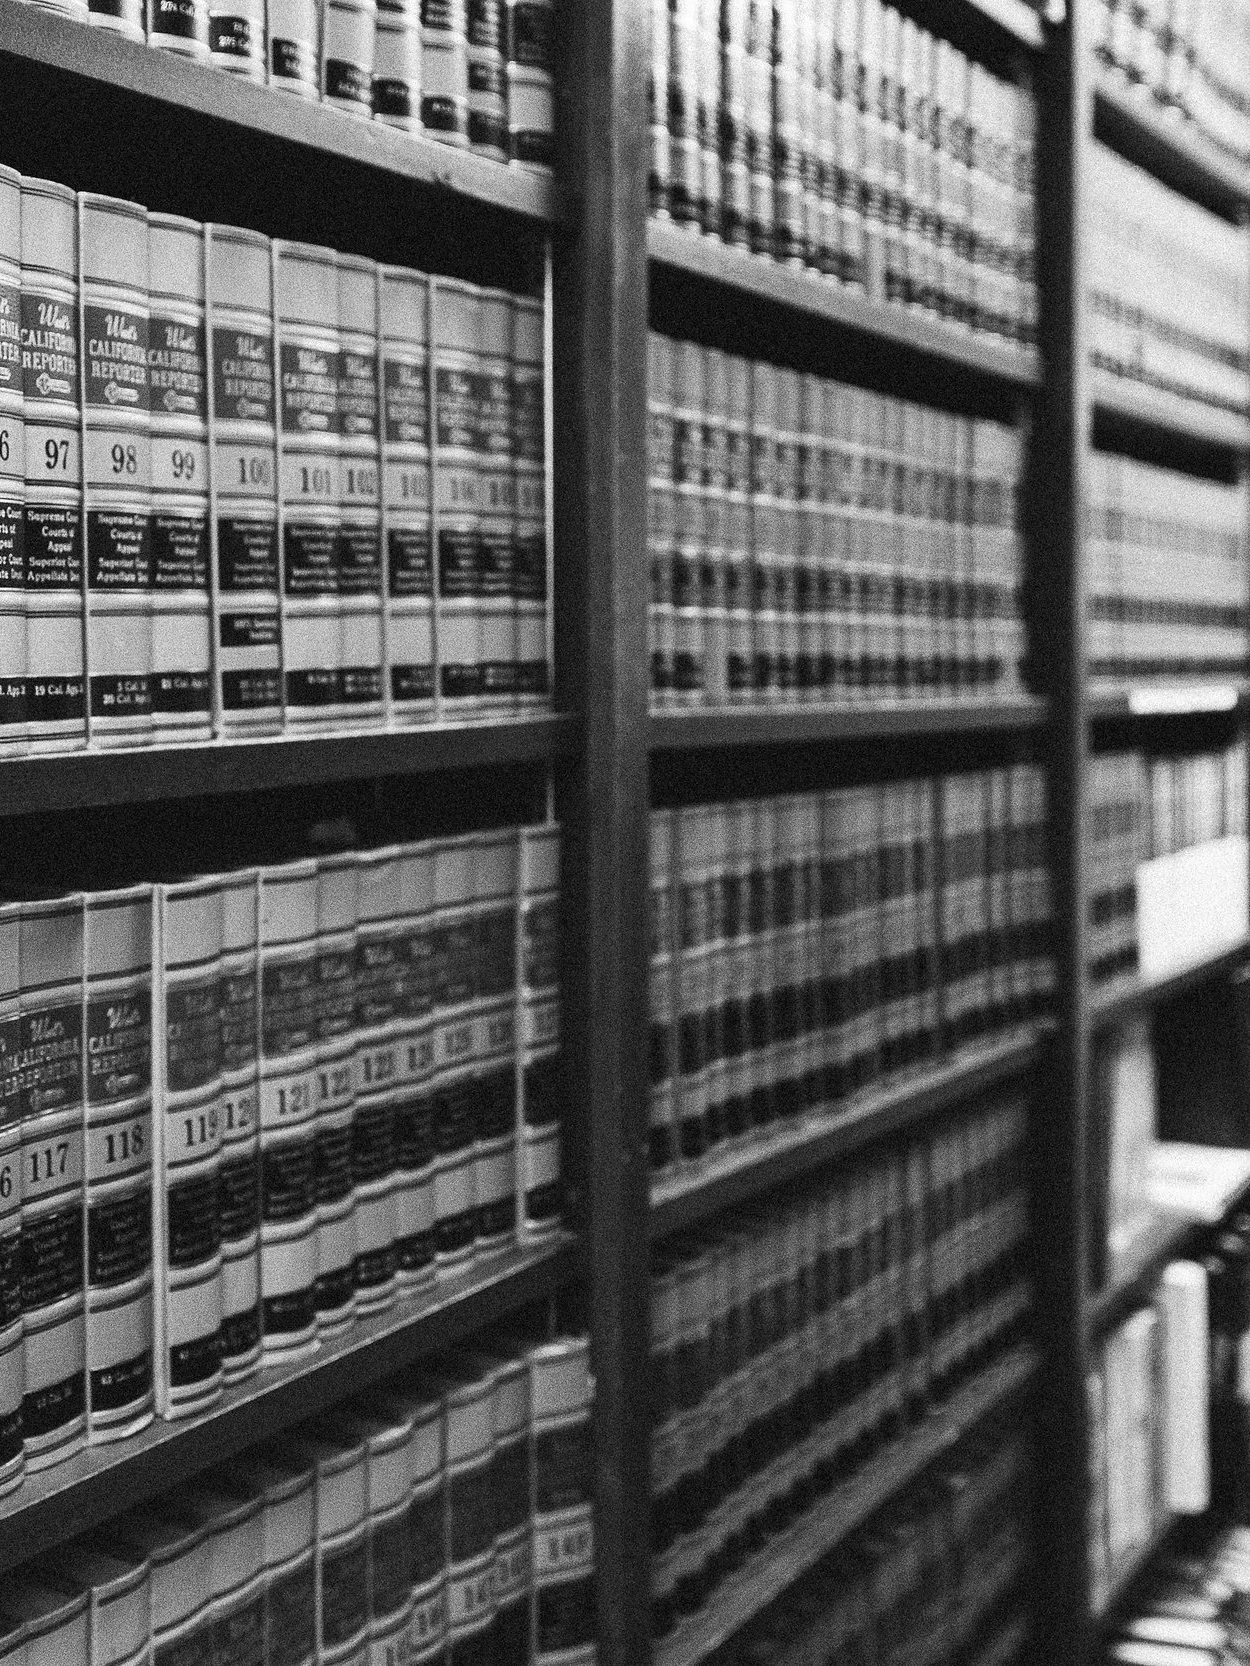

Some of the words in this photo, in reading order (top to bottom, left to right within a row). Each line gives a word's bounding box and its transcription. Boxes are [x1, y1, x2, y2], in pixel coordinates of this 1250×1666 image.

[45, 439, 69, 470] 97
[111, 443, 138, 475] 98
[105, 1124, 144, 1164] 118
[30, 1142, 69, 1183] 117
